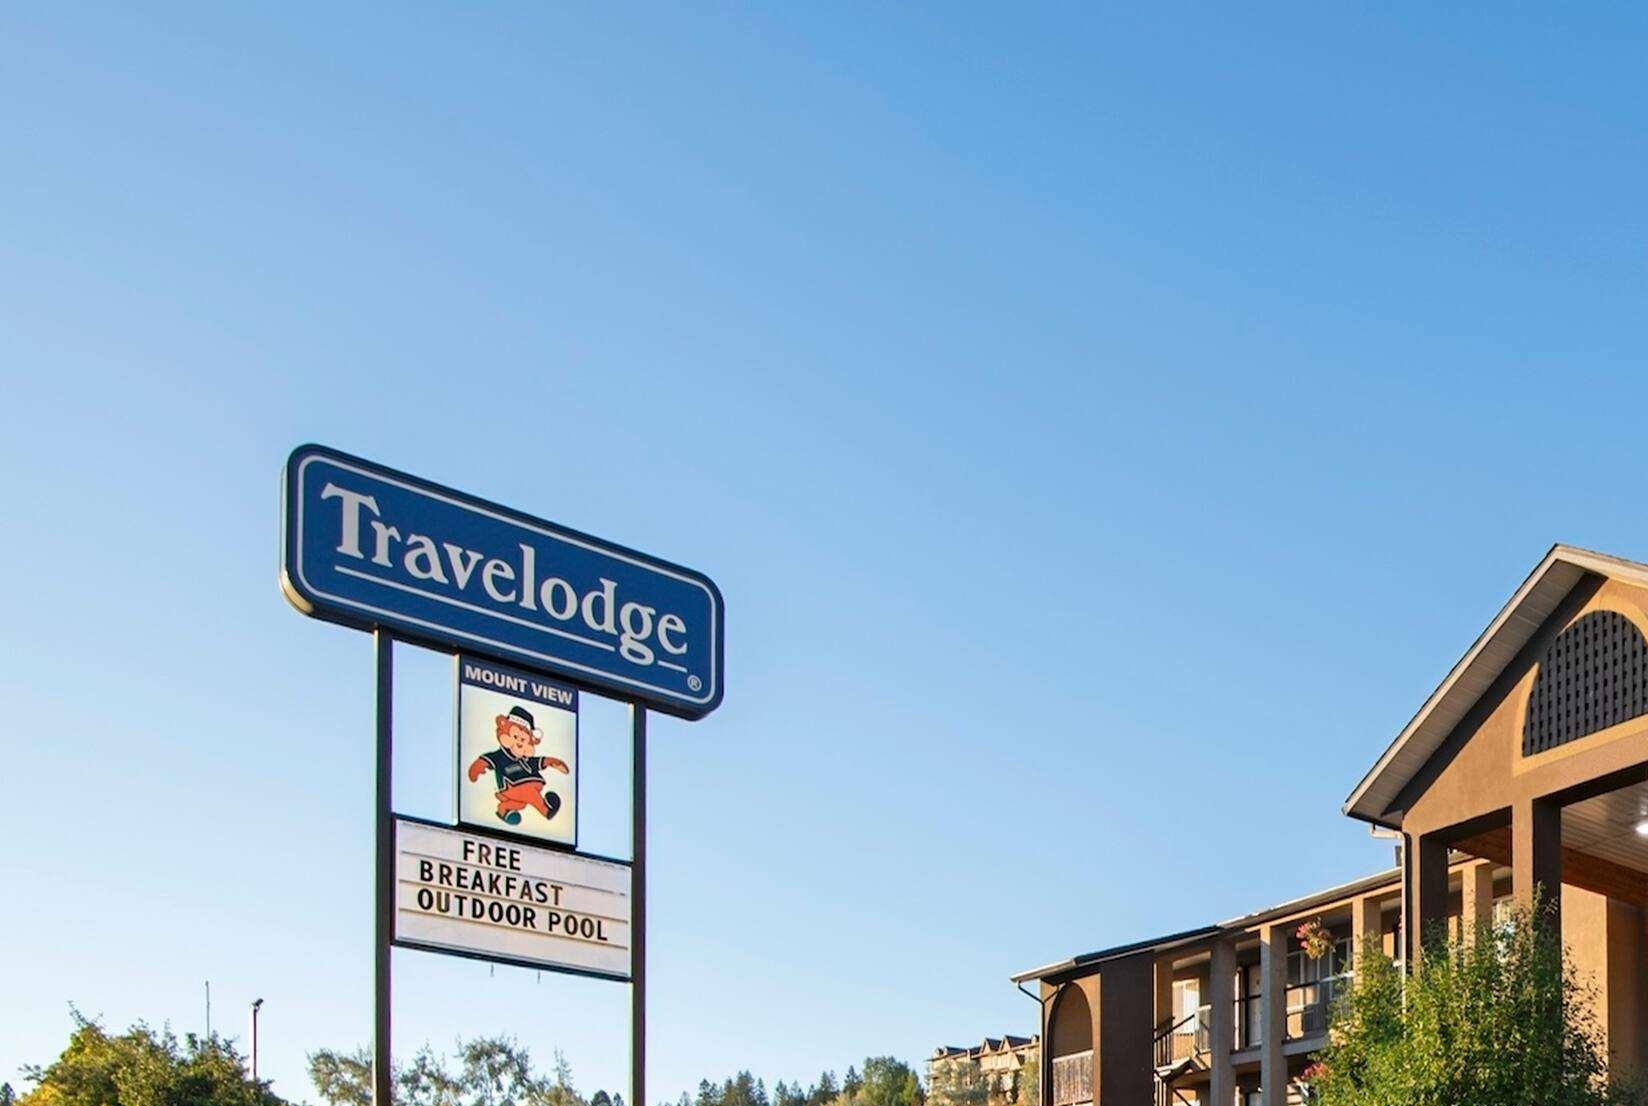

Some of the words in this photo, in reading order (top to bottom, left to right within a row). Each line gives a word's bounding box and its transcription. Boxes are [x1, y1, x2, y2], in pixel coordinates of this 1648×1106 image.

[321, 483, 688, 665] Travelodge
[465, 664, 528, 693] MOUNT
[531, 682, 573, 705] VIEW
[463, 839, 521, 872] FREE
[420, 859, 563, 906] BREAKFAST
[417, 888, 537, 930] OUTDOOR
[548, 912, 608, 942] POOL
